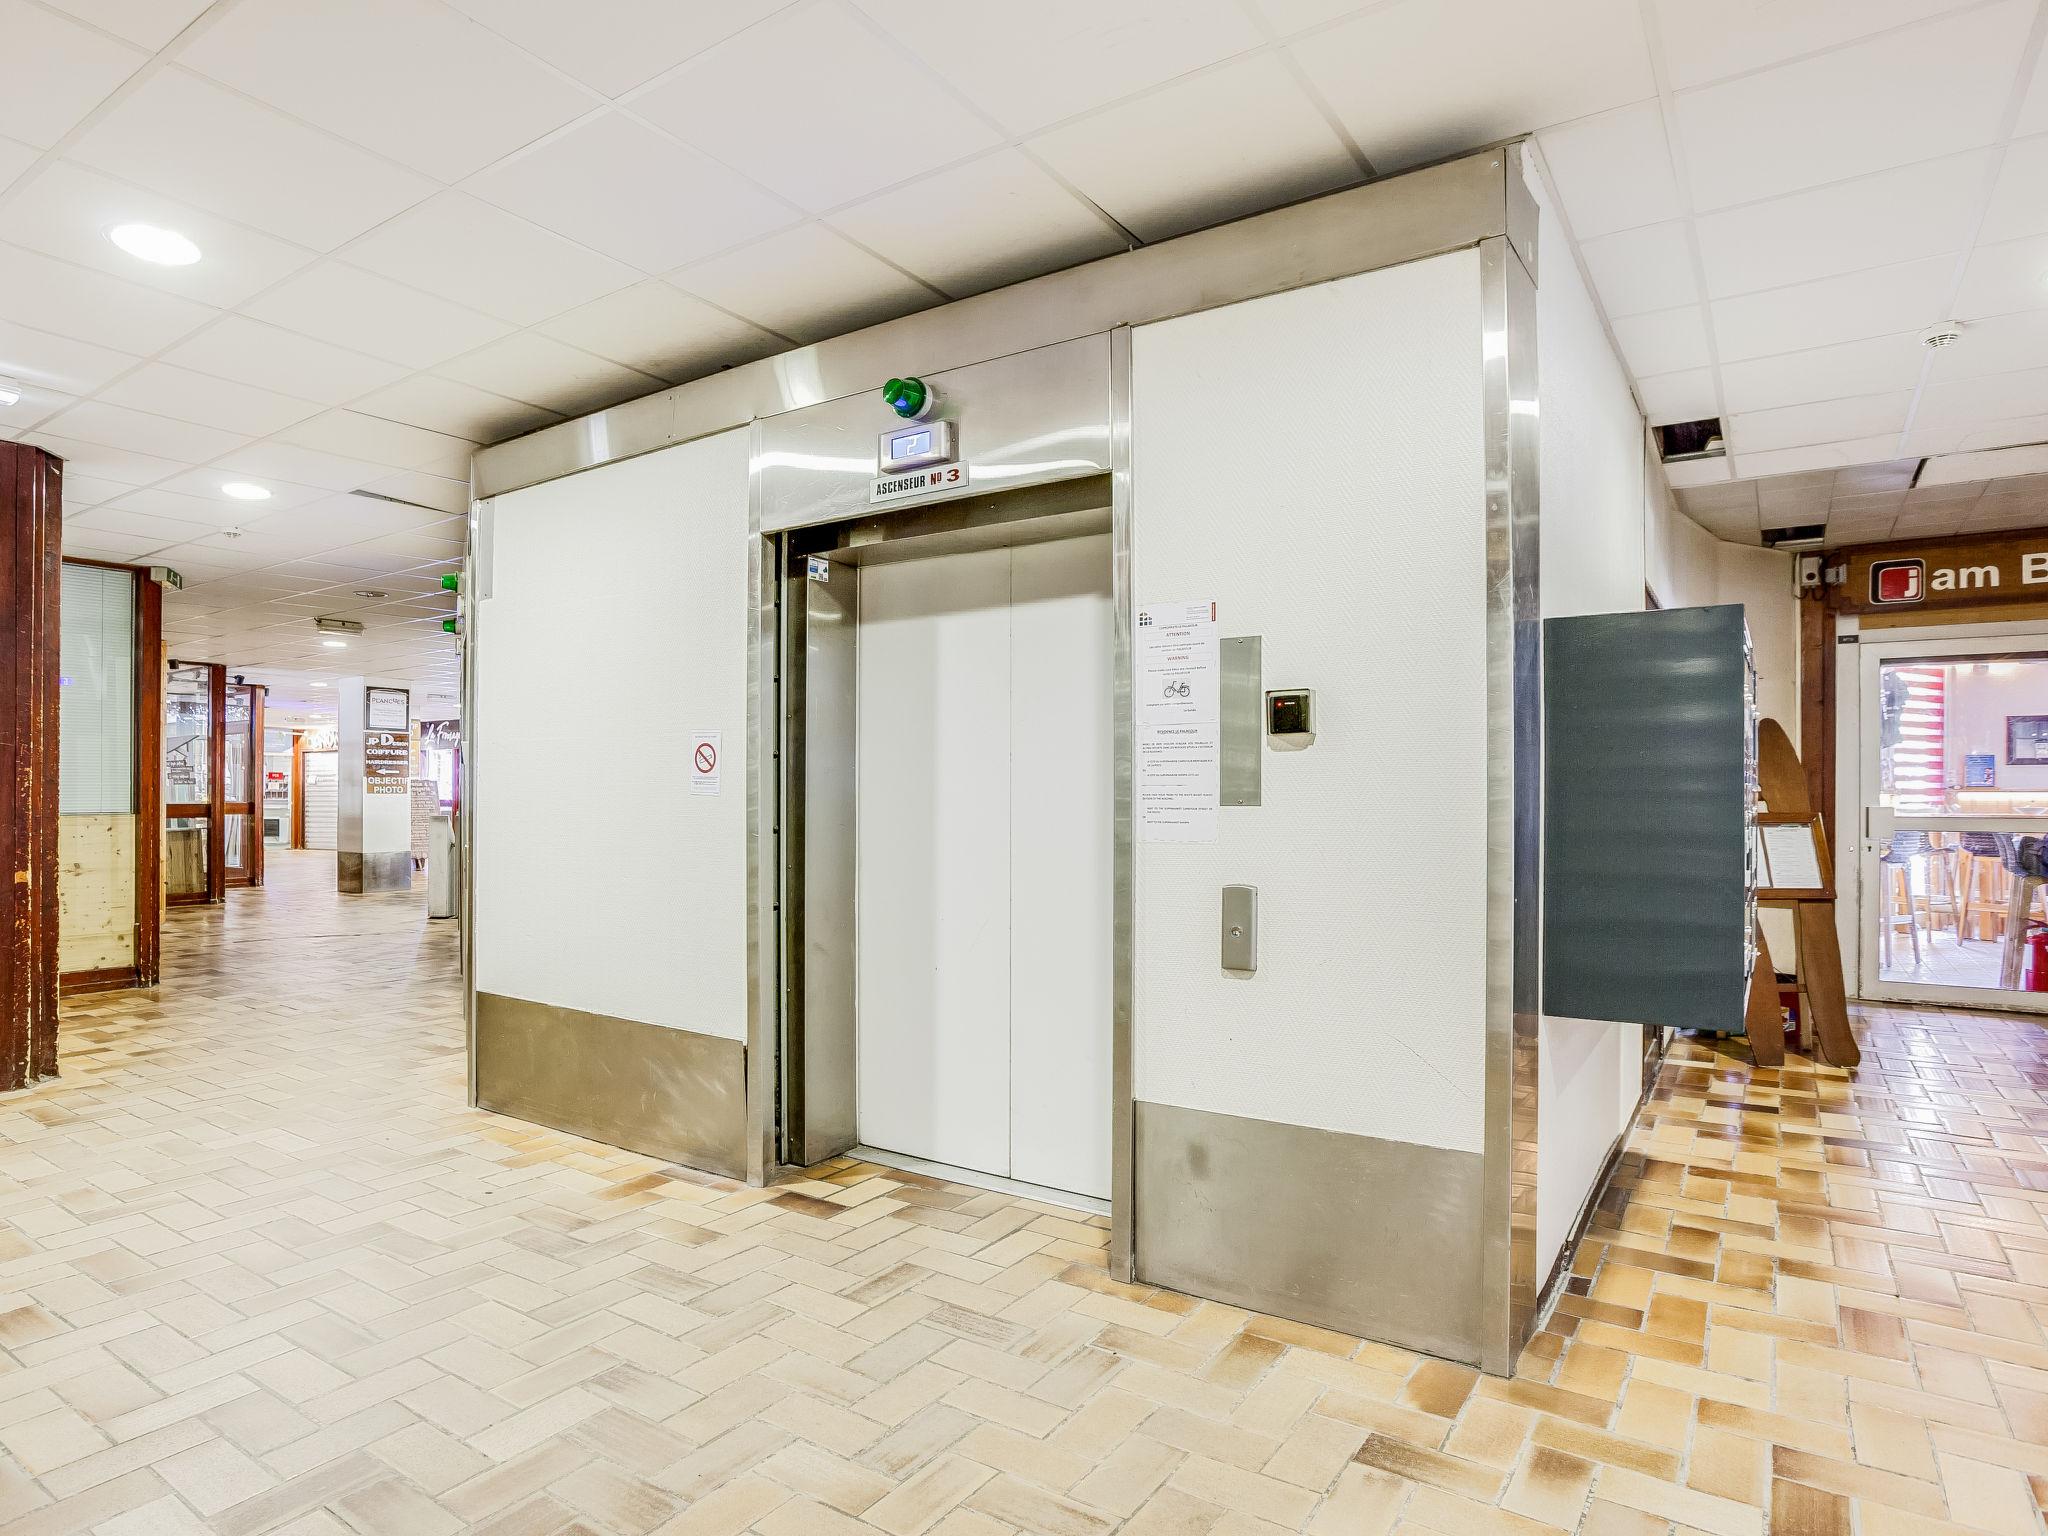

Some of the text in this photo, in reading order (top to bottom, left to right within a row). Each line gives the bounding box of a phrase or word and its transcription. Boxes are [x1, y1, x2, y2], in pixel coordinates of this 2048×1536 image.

[906, 437, 917, 455] 2
[876, 475, 926, 496] ASCENSEUR
[946, 468, 960, 482] 3
[366, 748, 408, 756] COIFFURE
[373, 785, 404, 794] PHOTO
